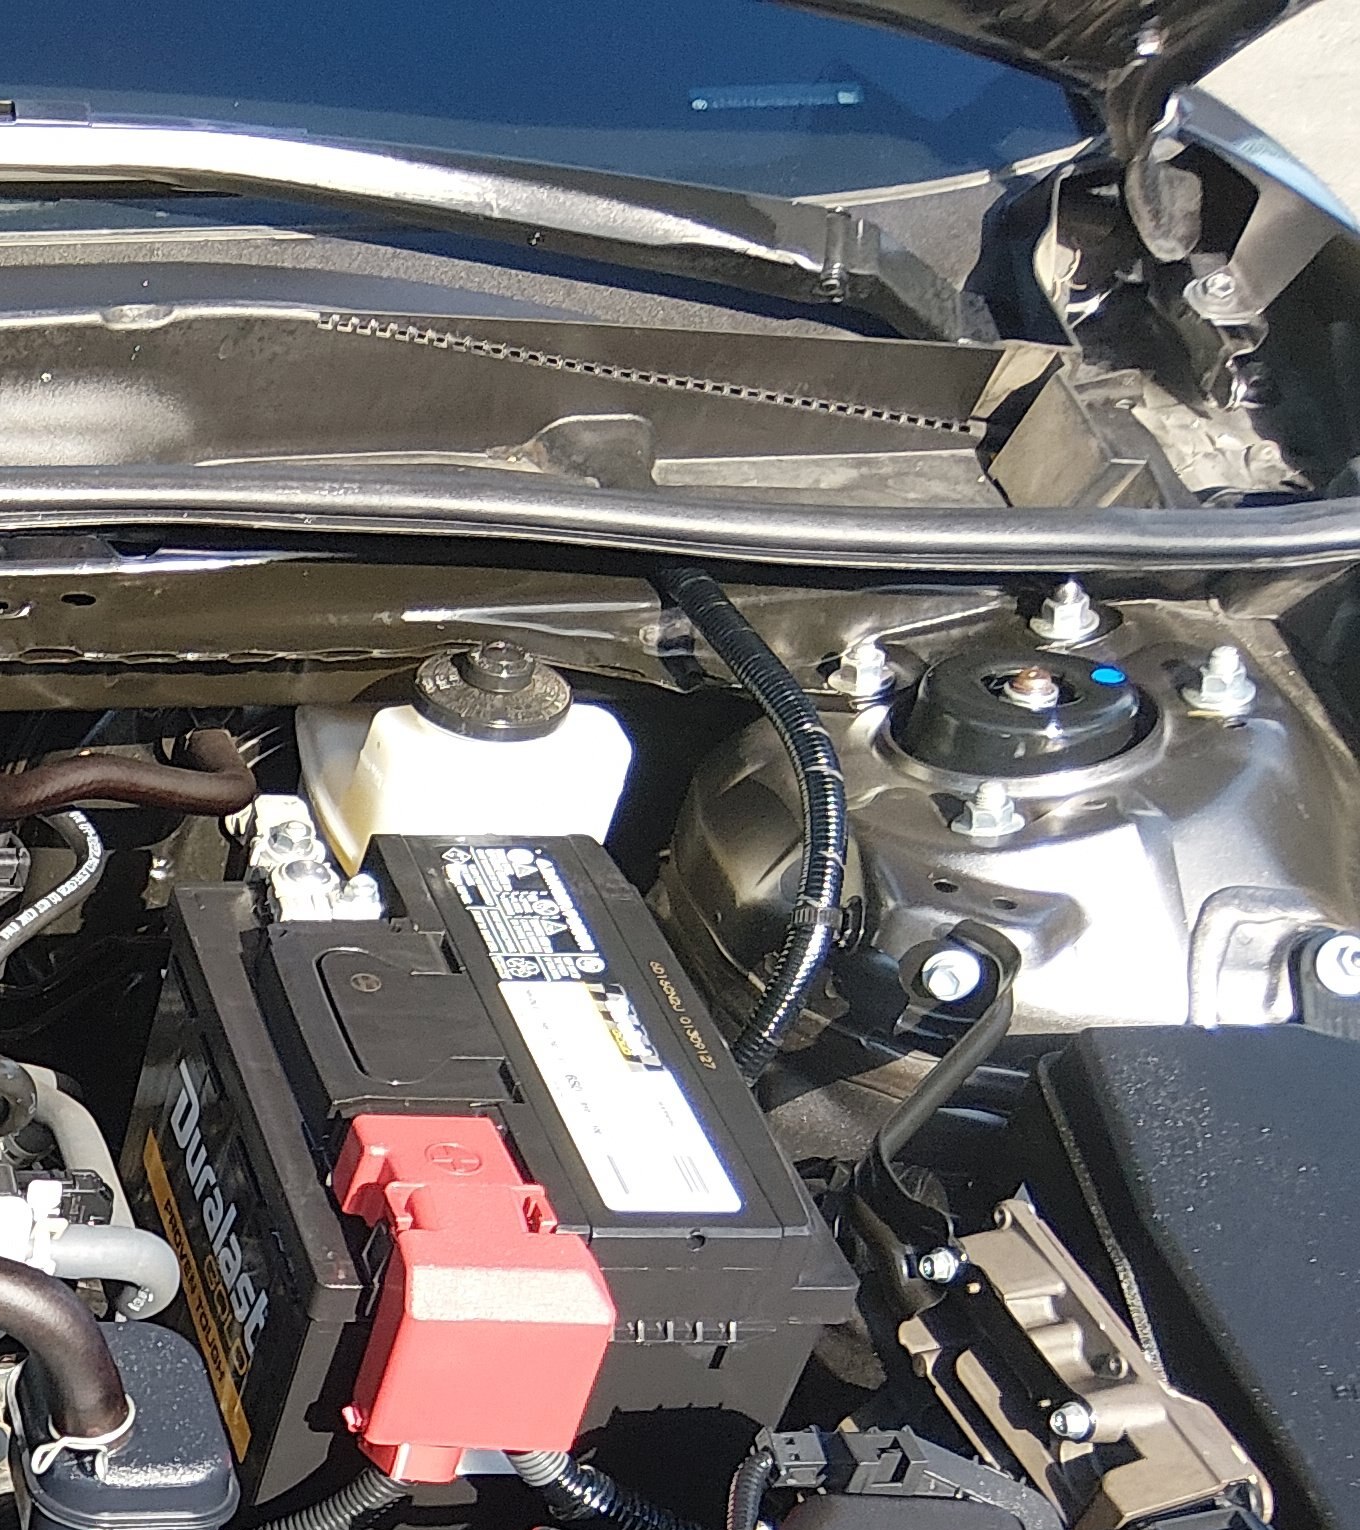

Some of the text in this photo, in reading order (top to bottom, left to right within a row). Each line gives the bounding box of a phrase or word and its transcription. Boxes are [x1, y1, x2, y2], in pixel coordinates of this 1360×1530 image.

[164, 1197, 226, 1383] PROVEN TOUGH
[170, 1059, 269, 1357] Duralast
[203, 1254, 248, 1376] GOLD
